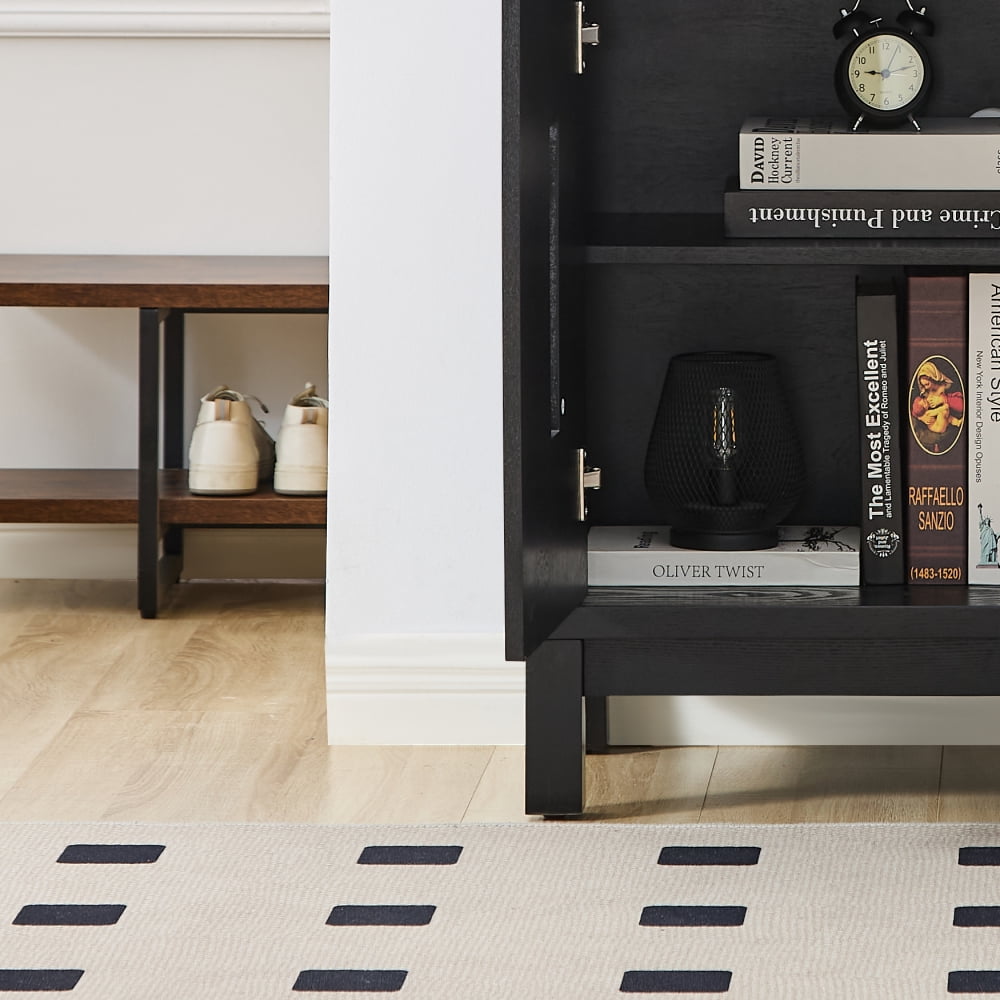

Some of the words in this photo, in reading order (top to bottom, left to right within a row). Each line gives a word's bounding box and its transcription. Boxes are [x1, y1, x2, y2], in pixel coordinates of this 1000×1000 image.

[869, 46, 875, 54] 11
[854, 69, 860, 78] 9
[859, 83, 865, 92] 8
[870, 94, 876, 102] 7
[884, 97, 890, 105] 6
[751, 137, 765, 183] DAVID
[768, 137, 781, 183] Hockney
[781, 137, 792, 184] Current
[749, 208, 884, 229] Punishment
[892, 209, 932, 228] and
[879, 340, 887, 362] Juliet
[976, 350, 984, 368] New
[864, 339, 881, 427] Excellent
[976, 370, 984, 389] York
[880, 380, 888, 409] Romeo
[975, 391, 984, 419] Interior
[880, 410, 888, 419] of
[881, 421, 891, 453] Tragedy
[974, 421, 983, 450] Design
[867, 432, 882, 479] Most
[883, 454, 891, 501] Lamentable
[974, 451, 983, 483] Opuses
[869, 486, 884, 520] The
[908, 486, 964, 506] RAFFAELLO
[918, 511, 954, 531] SANZIO
[653, 565, 711, 578] OLIVER
[715, 565, 764, 578] TWIST
[910, 566, 961, 580] (1483-1520)
